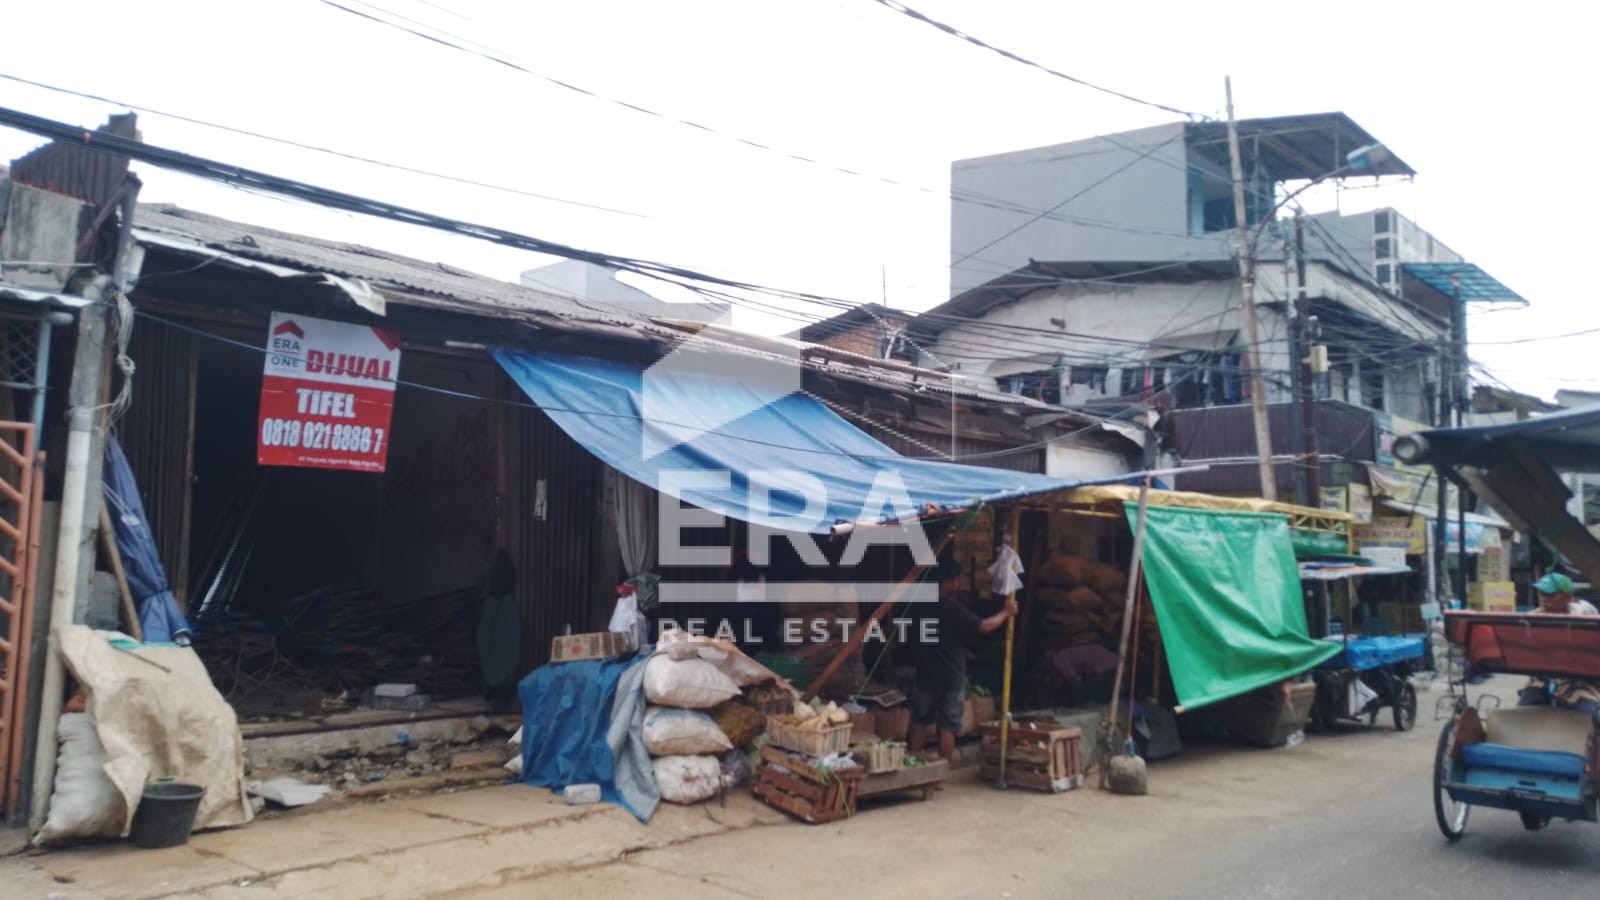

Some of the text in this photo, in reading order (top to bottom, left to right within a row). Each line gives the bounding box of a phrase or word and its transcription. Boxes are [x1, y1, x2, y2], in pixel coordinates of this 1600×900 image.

[272, 338, 300, 350] ERA
[271, 356, 300, 368] ONE
[305, 349, 395, 382] DIJUAL
[296, 388, 356, 418] TIFEL
[262, 418, 300, 447] 0818
